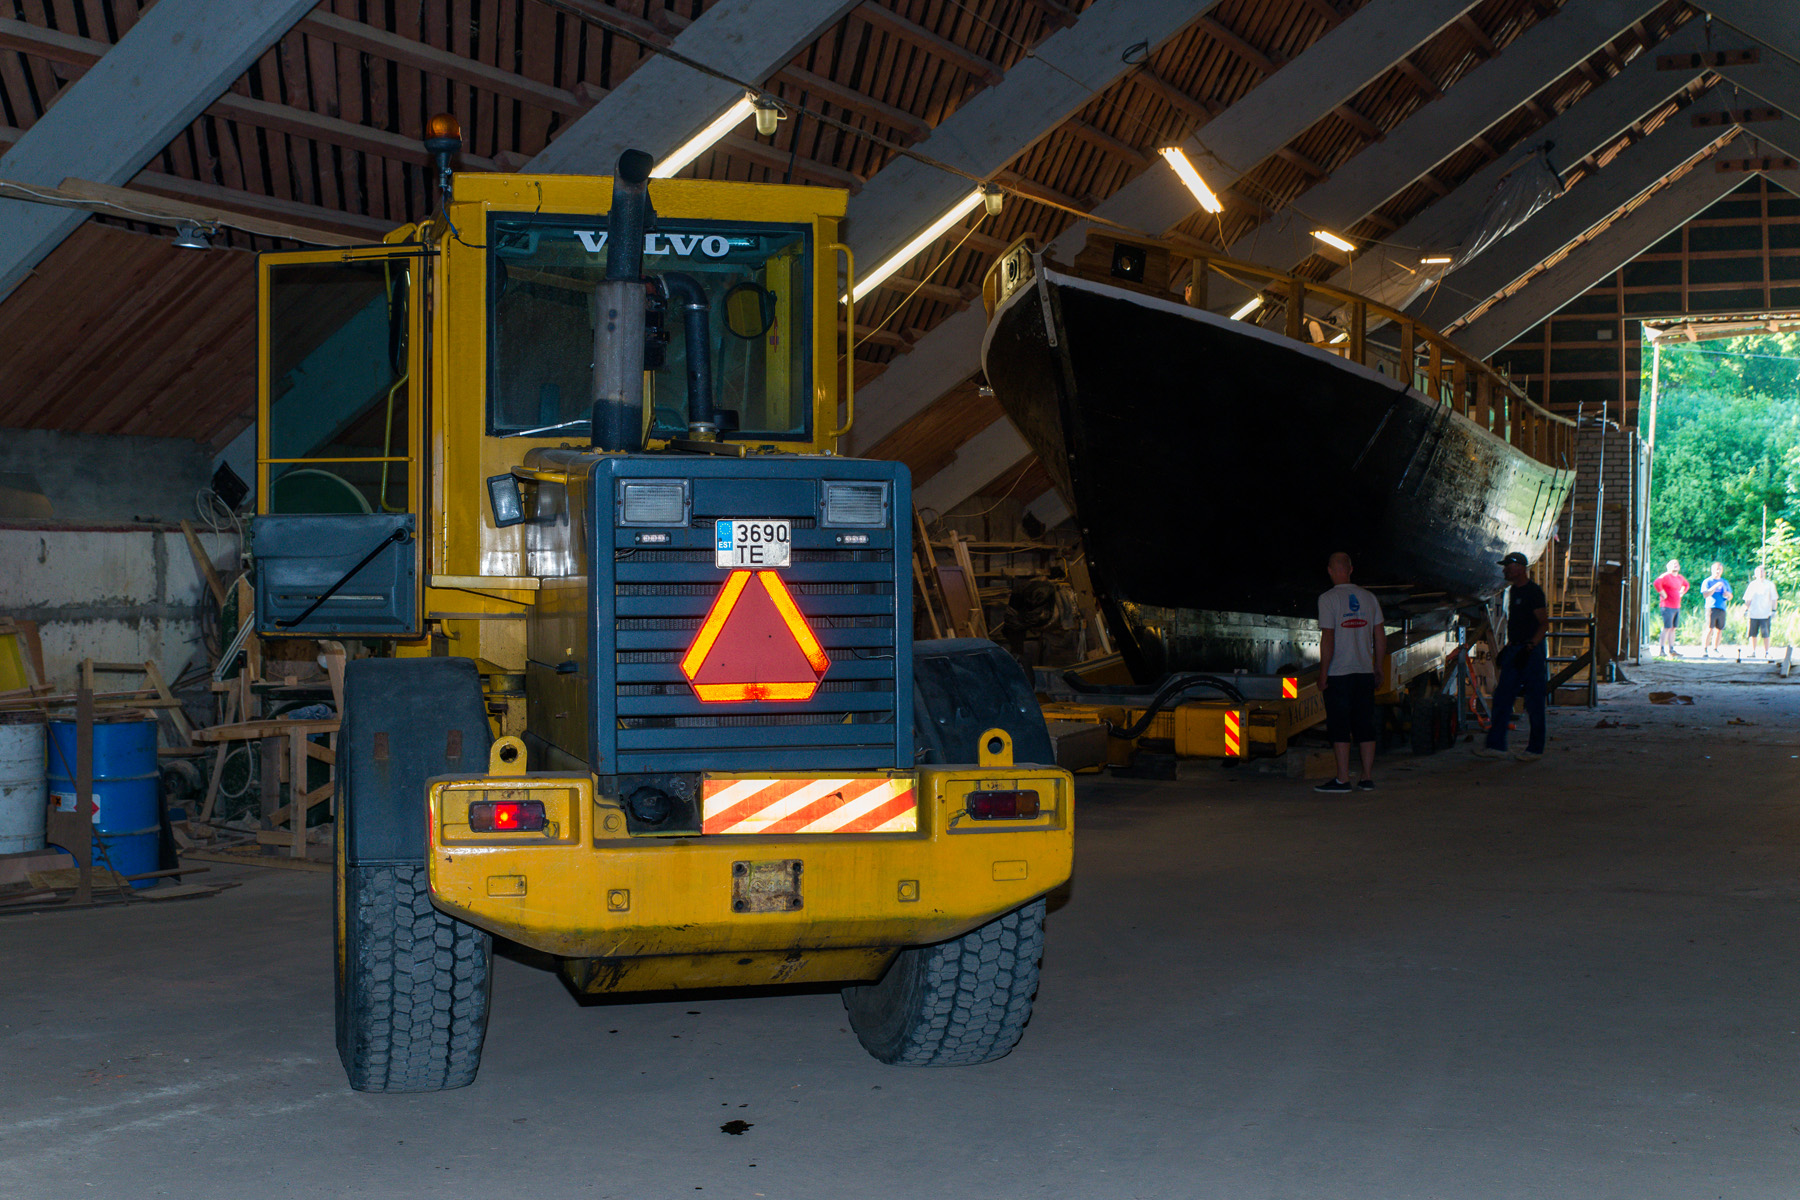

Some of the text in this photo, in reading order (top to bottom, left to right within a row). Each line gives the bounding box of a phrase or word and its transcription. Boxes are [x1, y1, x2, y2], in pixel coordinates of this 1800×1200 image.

[573, 230, 730, 257] VLVO
[737, 524, 787, 543] 3690
[719, 541, 732, 549] EST
[737, 545, 763, 563] TE
